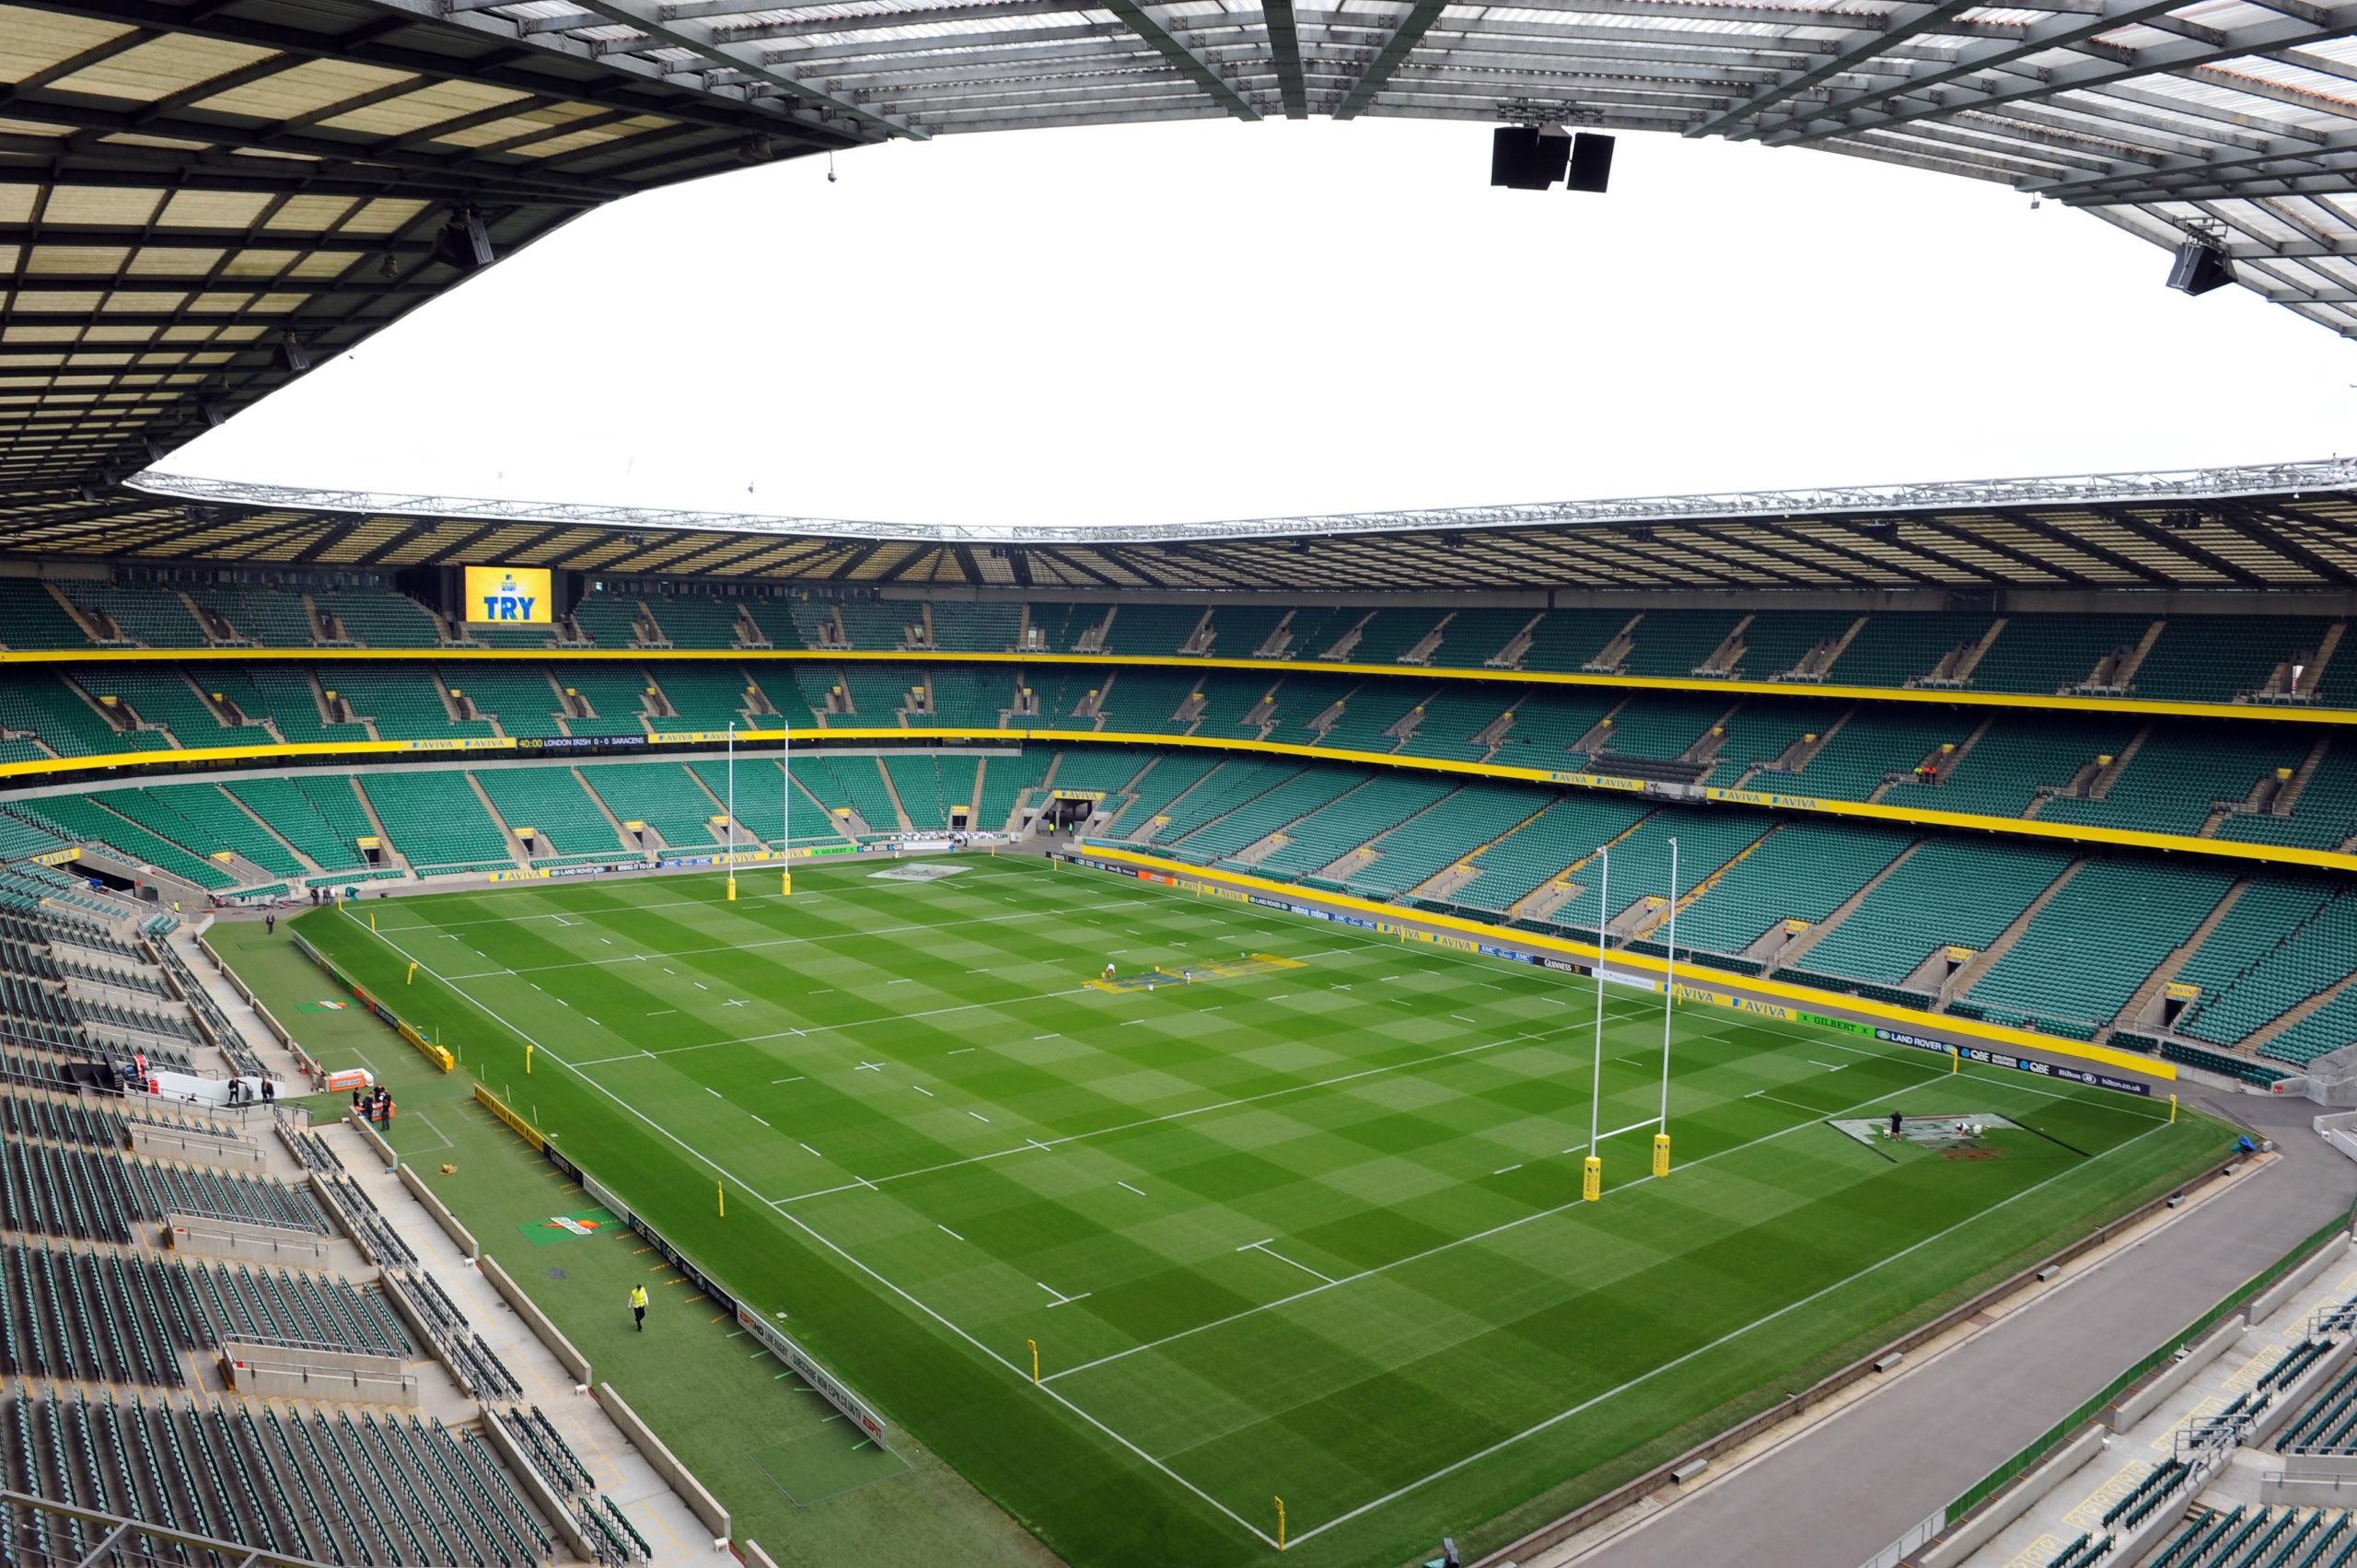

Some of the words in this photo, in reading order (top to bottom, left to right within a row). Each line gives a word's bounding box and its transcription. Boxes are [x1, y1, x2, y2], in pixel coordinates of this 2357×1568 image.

[484, 597, 535, 620] TRY
[422, 740, 453, 749] AVIVA
[473, 739, 505, 748] AVIVA
[518, 738, 543, 748] 40:00
[543, 738, 572, 747] LONDON
[573, 738, 591, 746] IRISH
[594, 738, 598, 746] 0
[611, 737, 644, 745] SARACENS
[1559, 774, 1586, 784] AVIVA
[1604, 779, 1633, 788] AVIVA
[1069, 791, 1097, 800] AVIVA
[1727, 792, 1760, 802] AVIVA
[1782, 797, 1817, 808] AVIVA
[821, 847, 847, 855] GILBERT
[45, 851, 74, 865] AVIVA
[508, 870, 542, 880] AVIVA
[1222, 889, 1243, 900] AVIVA
[1292, 905, 1308, 915] mbna
[1311, 909, 1329, 920] mbna
[1442, 935, 1471, 950] AVIVA
[1544, 958, 1572, 971] GUINNESS
[1745, 1002, 1786, 1018] AVIVA
[1814, 1016, 1856, 1032] GILBERT
[1891, 1033, 1912, 1044] LAND
[1914, 1037, 1942, 1051] ROVER
[1970, 1050, 1990, 1063] QBE
[2029, 1062, 2049, 1074] QBE
[2058, 1068, 2081, 1080] Hilton
[2101, 1077, 2141, 1093] hilton.co.uk
[765, 1330, 774, 1347] LIVE
[774, 1338, 788, 1358] RUGBY
[793, 1353, 817, 1382] SUBSCRIBE
[818, 1376, 828, 1393] NOW
[863, 1414, 882, 1439] ESPN
